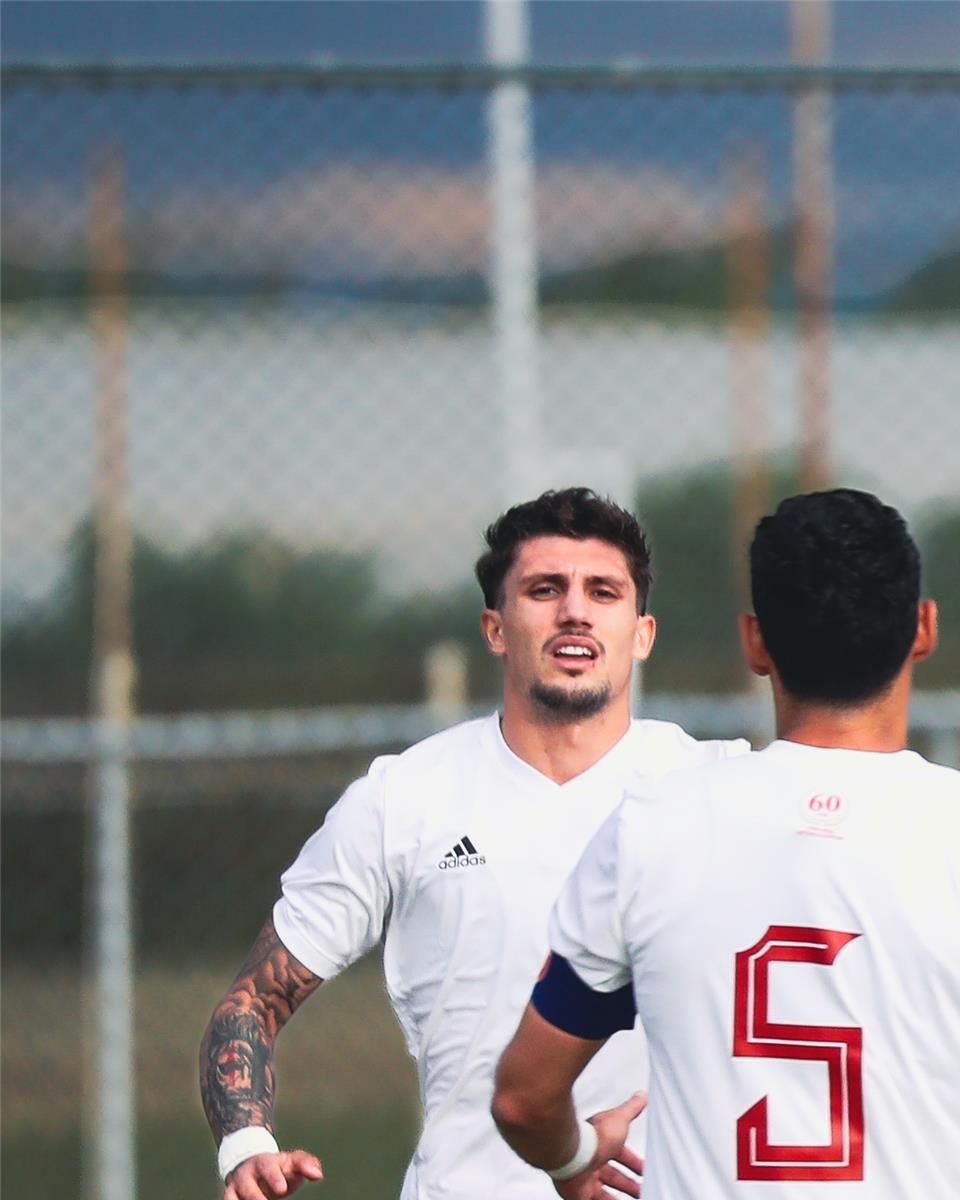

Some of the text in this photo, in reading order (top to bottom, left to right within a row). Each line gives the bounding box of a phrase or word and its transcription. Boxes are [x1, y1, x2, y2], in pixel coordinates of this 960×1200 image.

[808, 792, 841, 812] 60
[438, 855, 487, 870] adidas
[732, 924, 864, 1182] 5
